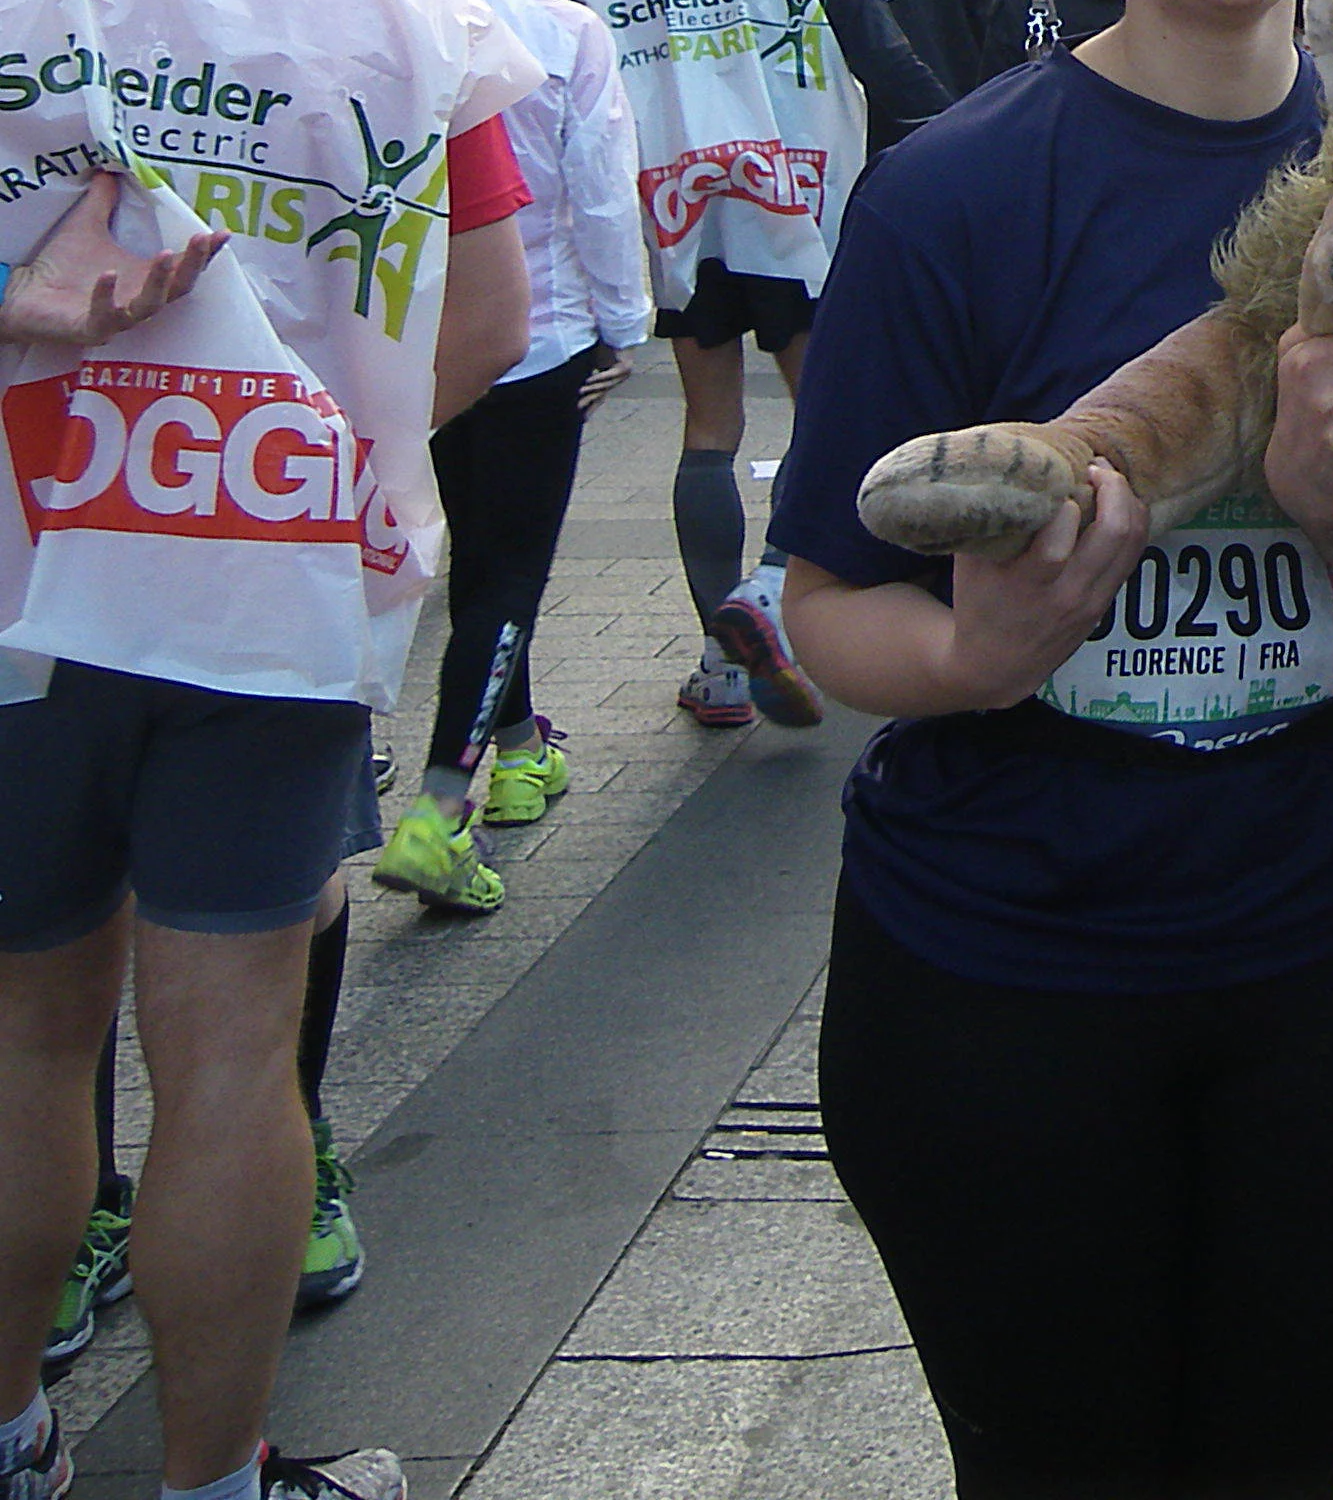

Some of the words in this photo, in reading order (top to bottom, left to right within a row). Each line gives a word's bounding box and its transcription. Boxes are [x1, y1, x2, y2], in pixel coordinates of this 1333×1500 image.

[240, 377, 276, 400] DE
[1105, 647, 1227, 679] FLORENCE
[1259, 639, 1300, 671] FRA
